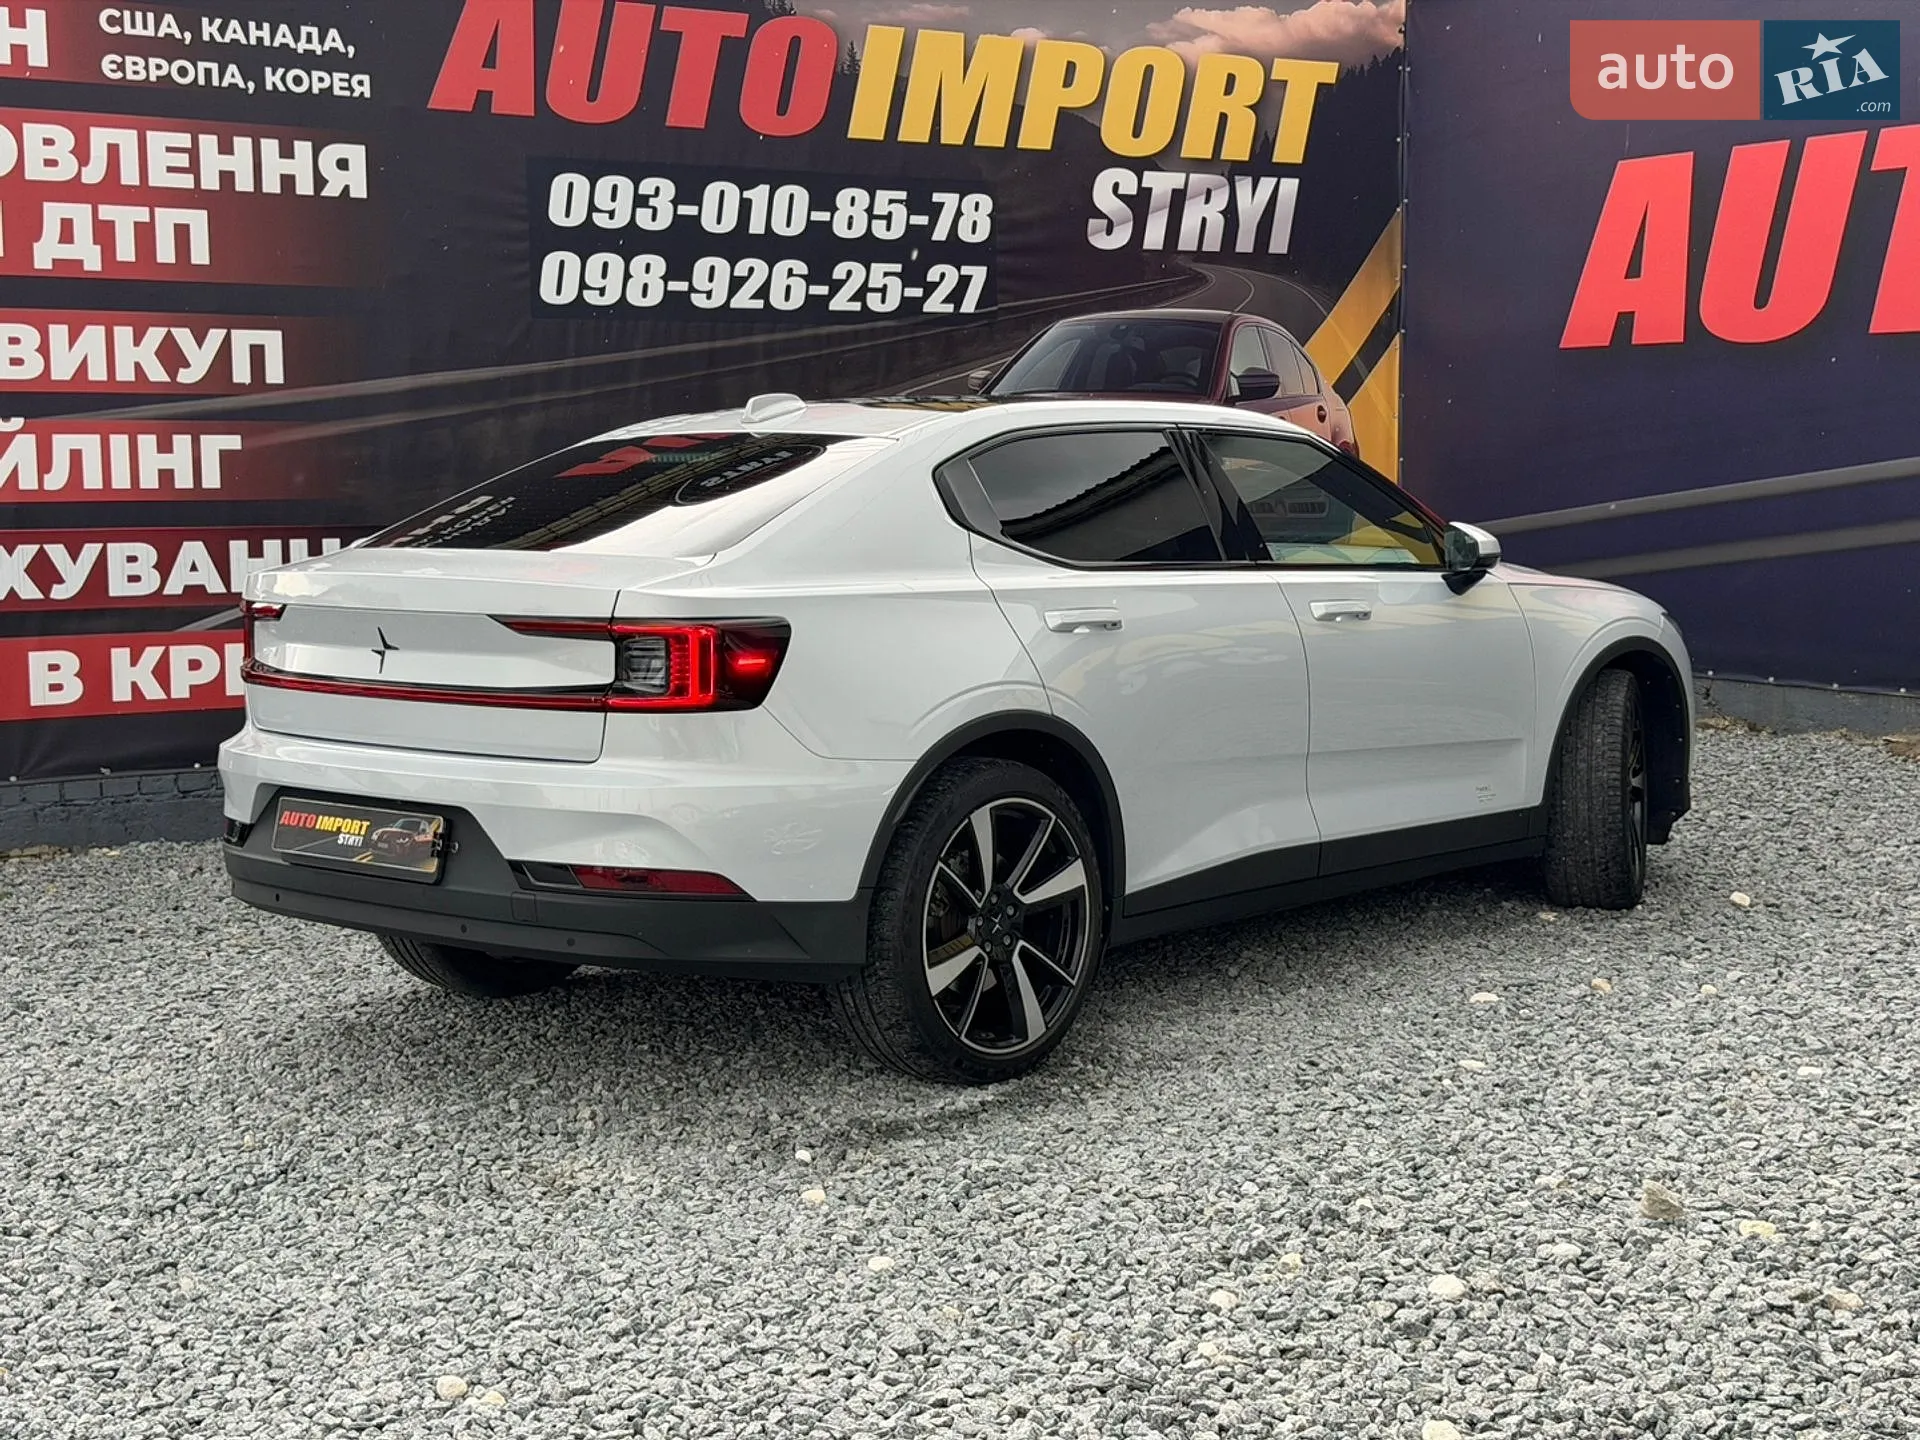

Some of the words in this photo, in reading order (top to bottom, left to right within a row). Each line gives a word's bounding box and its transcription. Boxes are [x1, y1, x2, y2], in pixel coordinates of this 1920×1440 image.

[99, 9, 192, 45] США,
[201, 17, 355, 58] КАНАДА,
[102, 54, 256, 94] ЄВРОПА,
[265, 67, 371, 98] КОРЕЯ
[33, 201, 210, 271] ДТП
[548, 172, 993, 243] 093-010-85-78
[1087, 167, 1300, 254] STRYI
[539, 250, 988, 313] 098-926-25-27
[0, 323, 284, 385] ВИКУП
[0, 416, 242, 491] ЙЛІНГ
[29, 650, 84, 706] В
